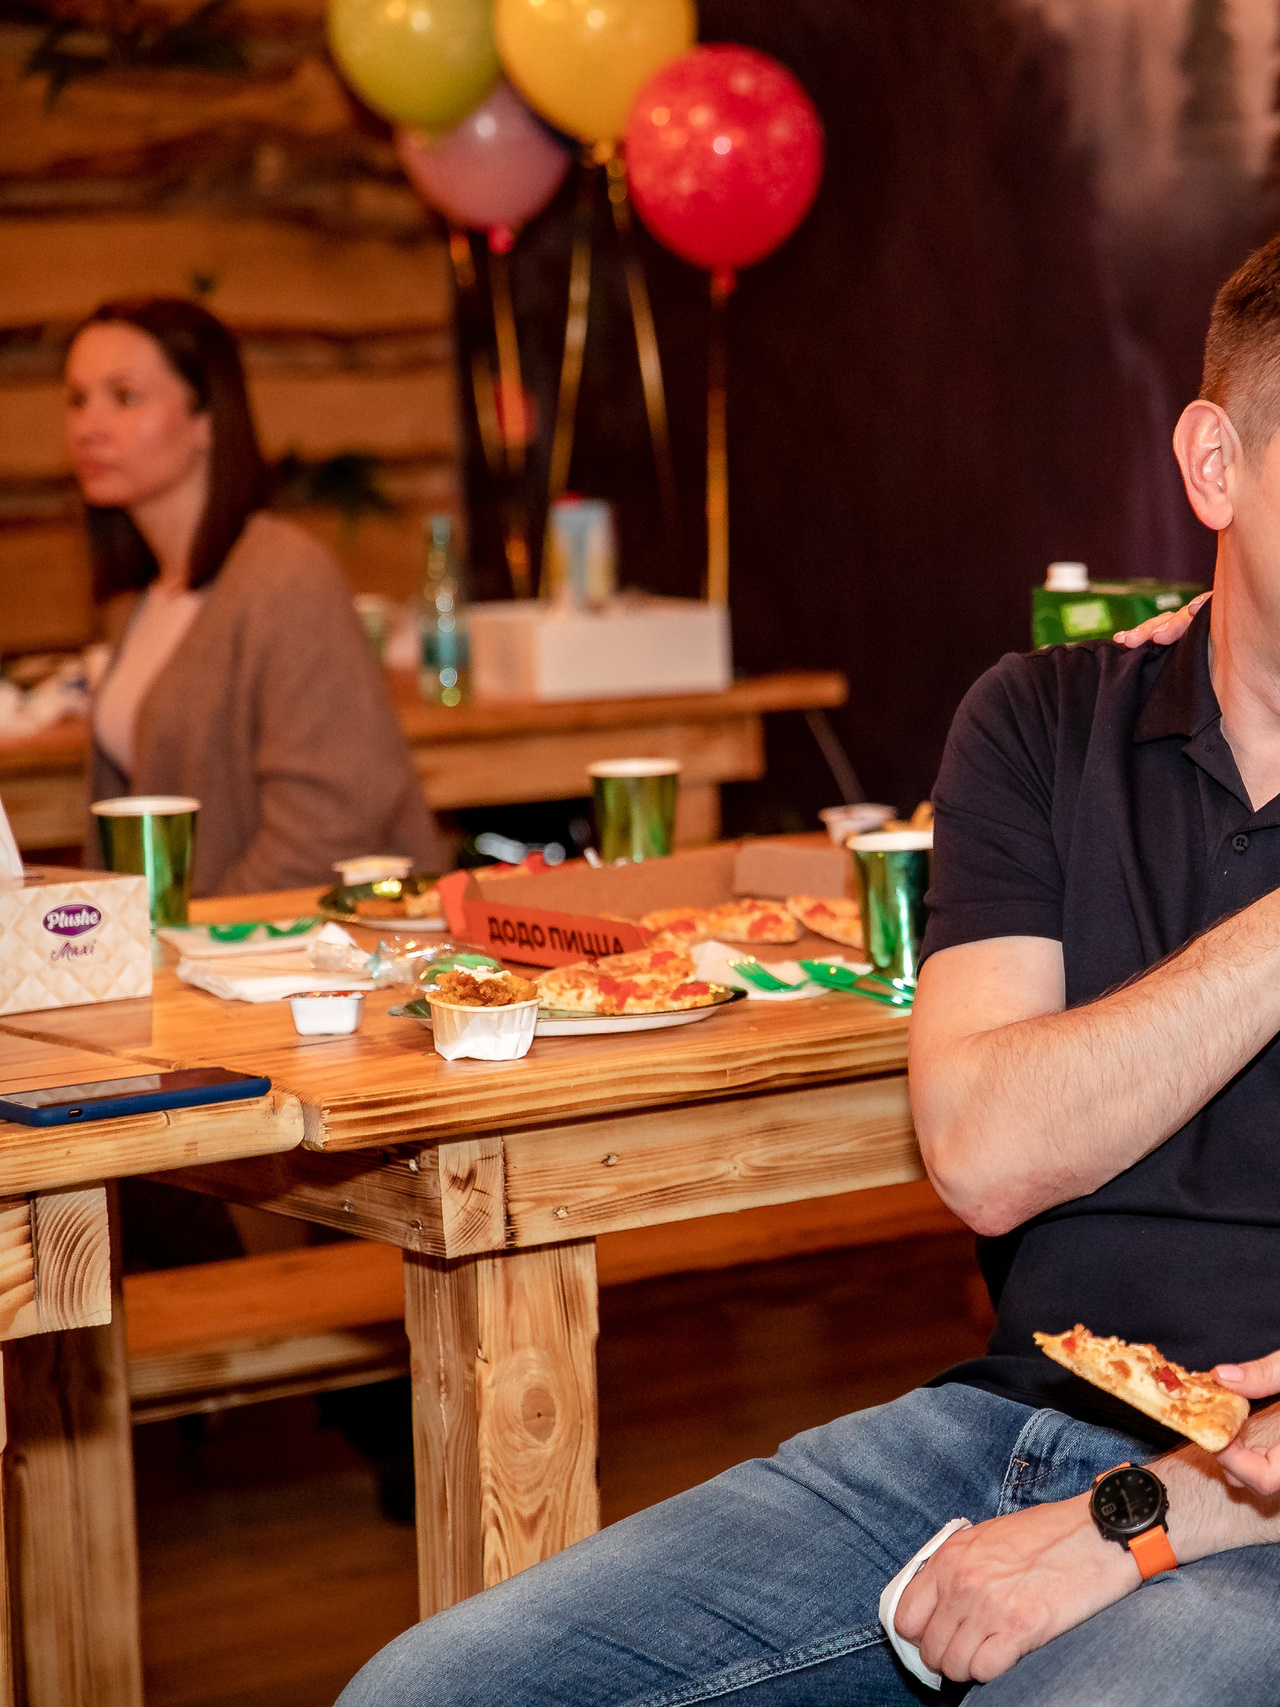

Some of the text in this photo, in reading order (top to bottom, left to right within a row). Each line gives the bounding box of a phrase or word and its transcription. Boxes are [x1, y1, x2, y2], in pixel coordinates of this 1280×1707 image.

[46, 908, 99, 930] Plushe
[487, 917, 625, 958] ДОДО ПИЦЦА
[50, 939, 97, 962] Maxi
